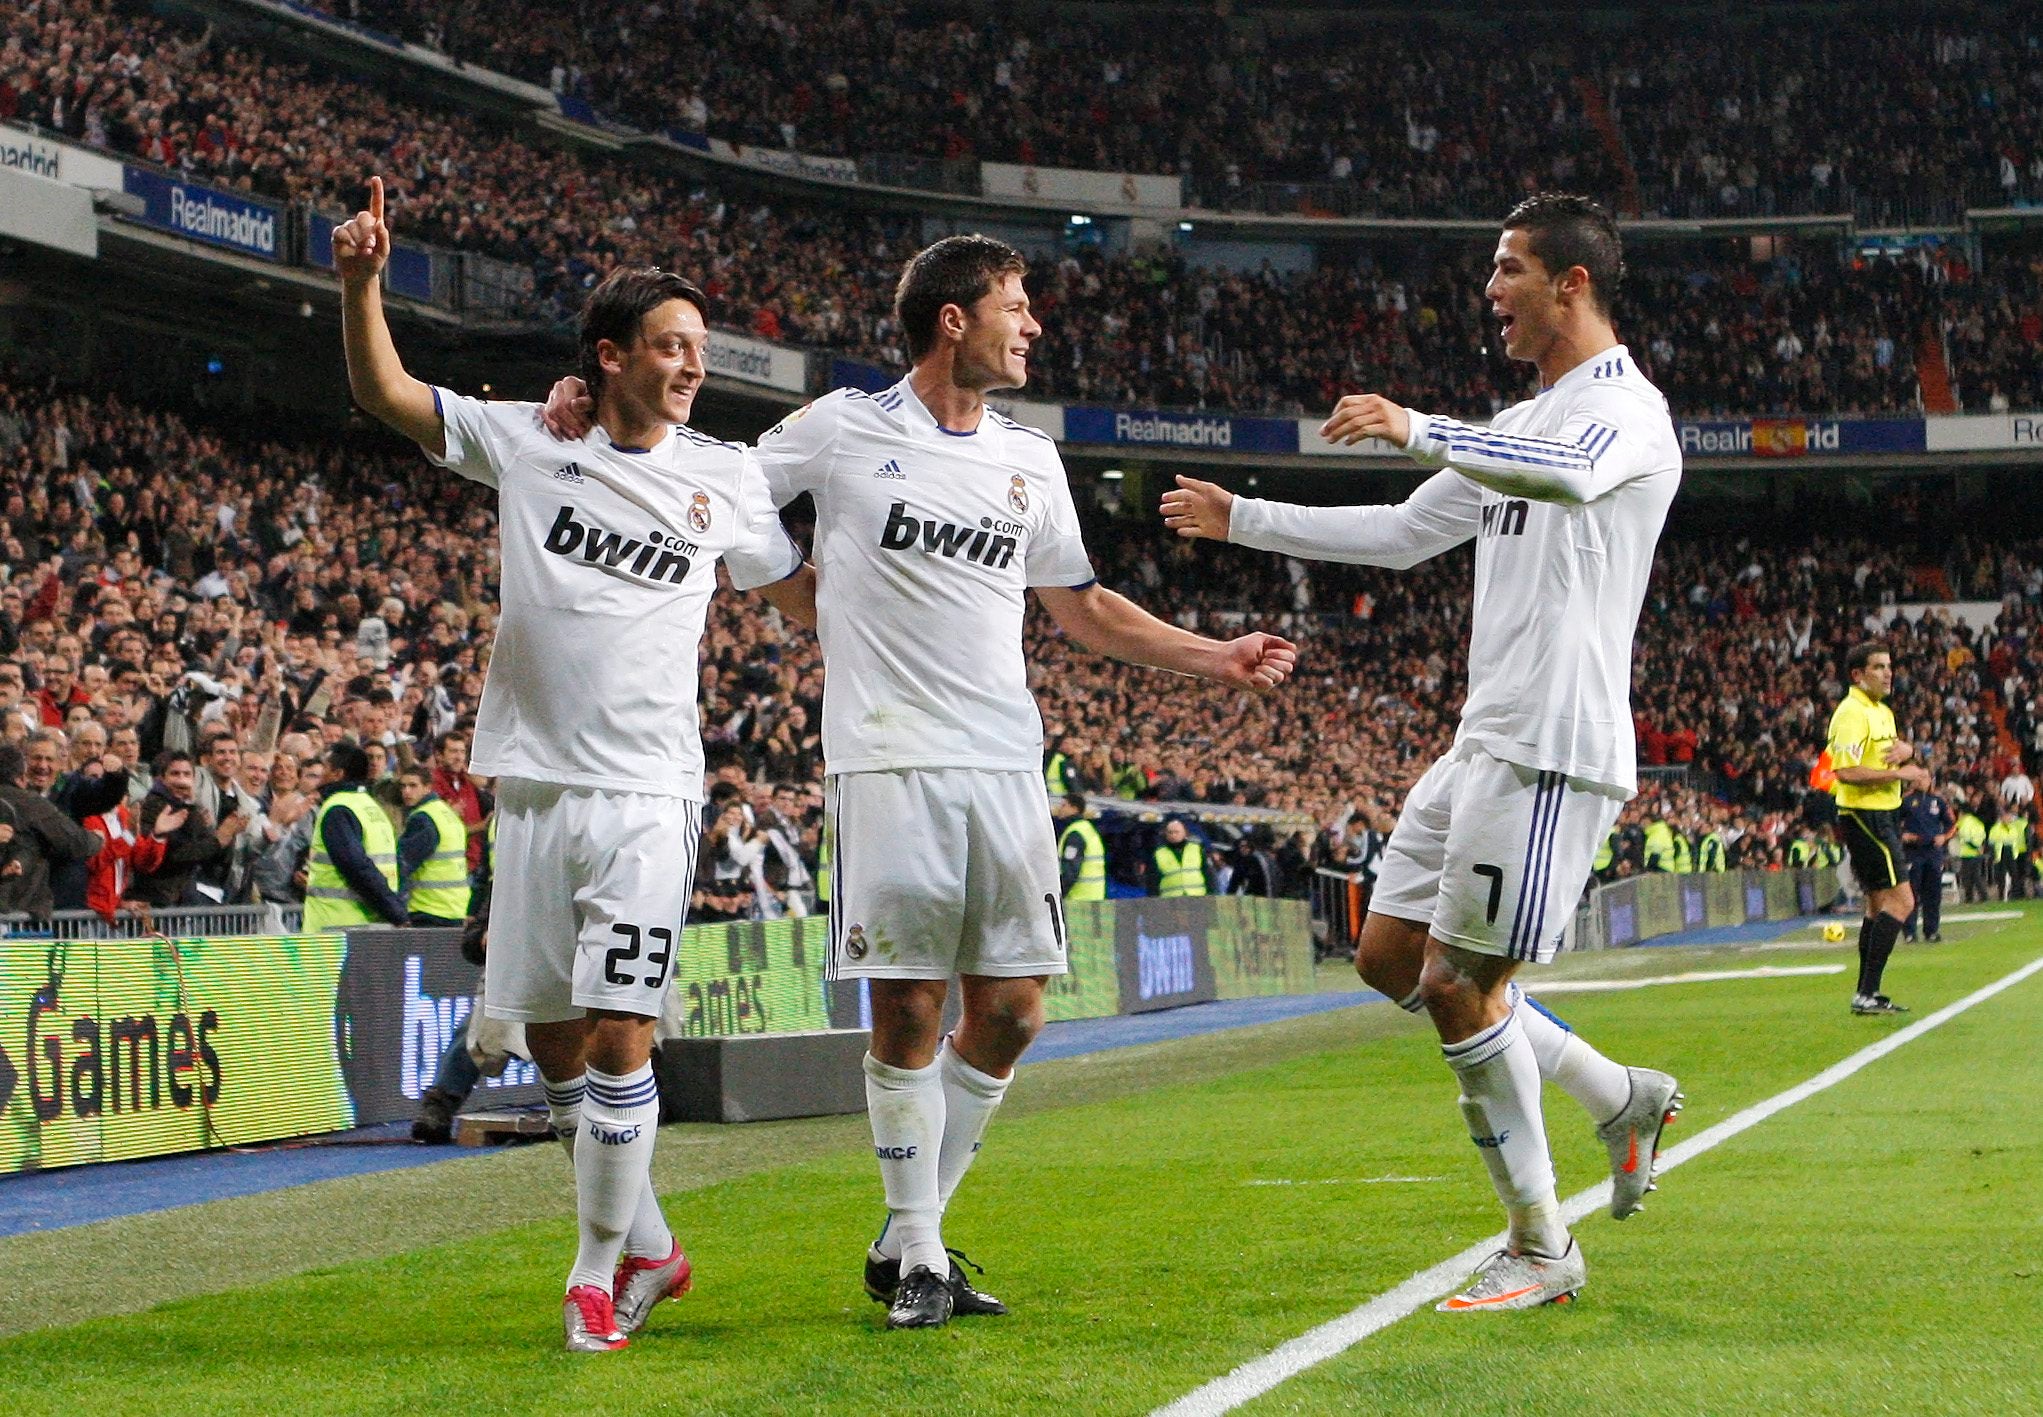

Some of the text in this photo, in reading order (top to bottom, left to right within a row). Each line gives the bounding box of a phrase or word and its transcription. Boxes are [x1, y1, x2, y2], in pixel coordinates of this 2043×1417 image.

[0, 142, 59, 178] adrid
[171, 186, 273, 252] Realmadrid
[709, 344, 770, 377] ealmadrid
[1116, 413, 1231, 446] Realmadrid
[1682, 422, 1840, 451] Realrid
[873, 471, 906, 480] adidas
[544, 506, 691, 584] bwin
[880, 502, 1016, 569] bwin
[1472, 863, 1503, 927] 7
[605, 922, 672, 989] 23
[682, 973, 766, 1036] ames
[26, 982, 221, 1121] Games
[590, 1123, 642, 1146] RMCF
[875, 1145, 918, 1160] MCF
